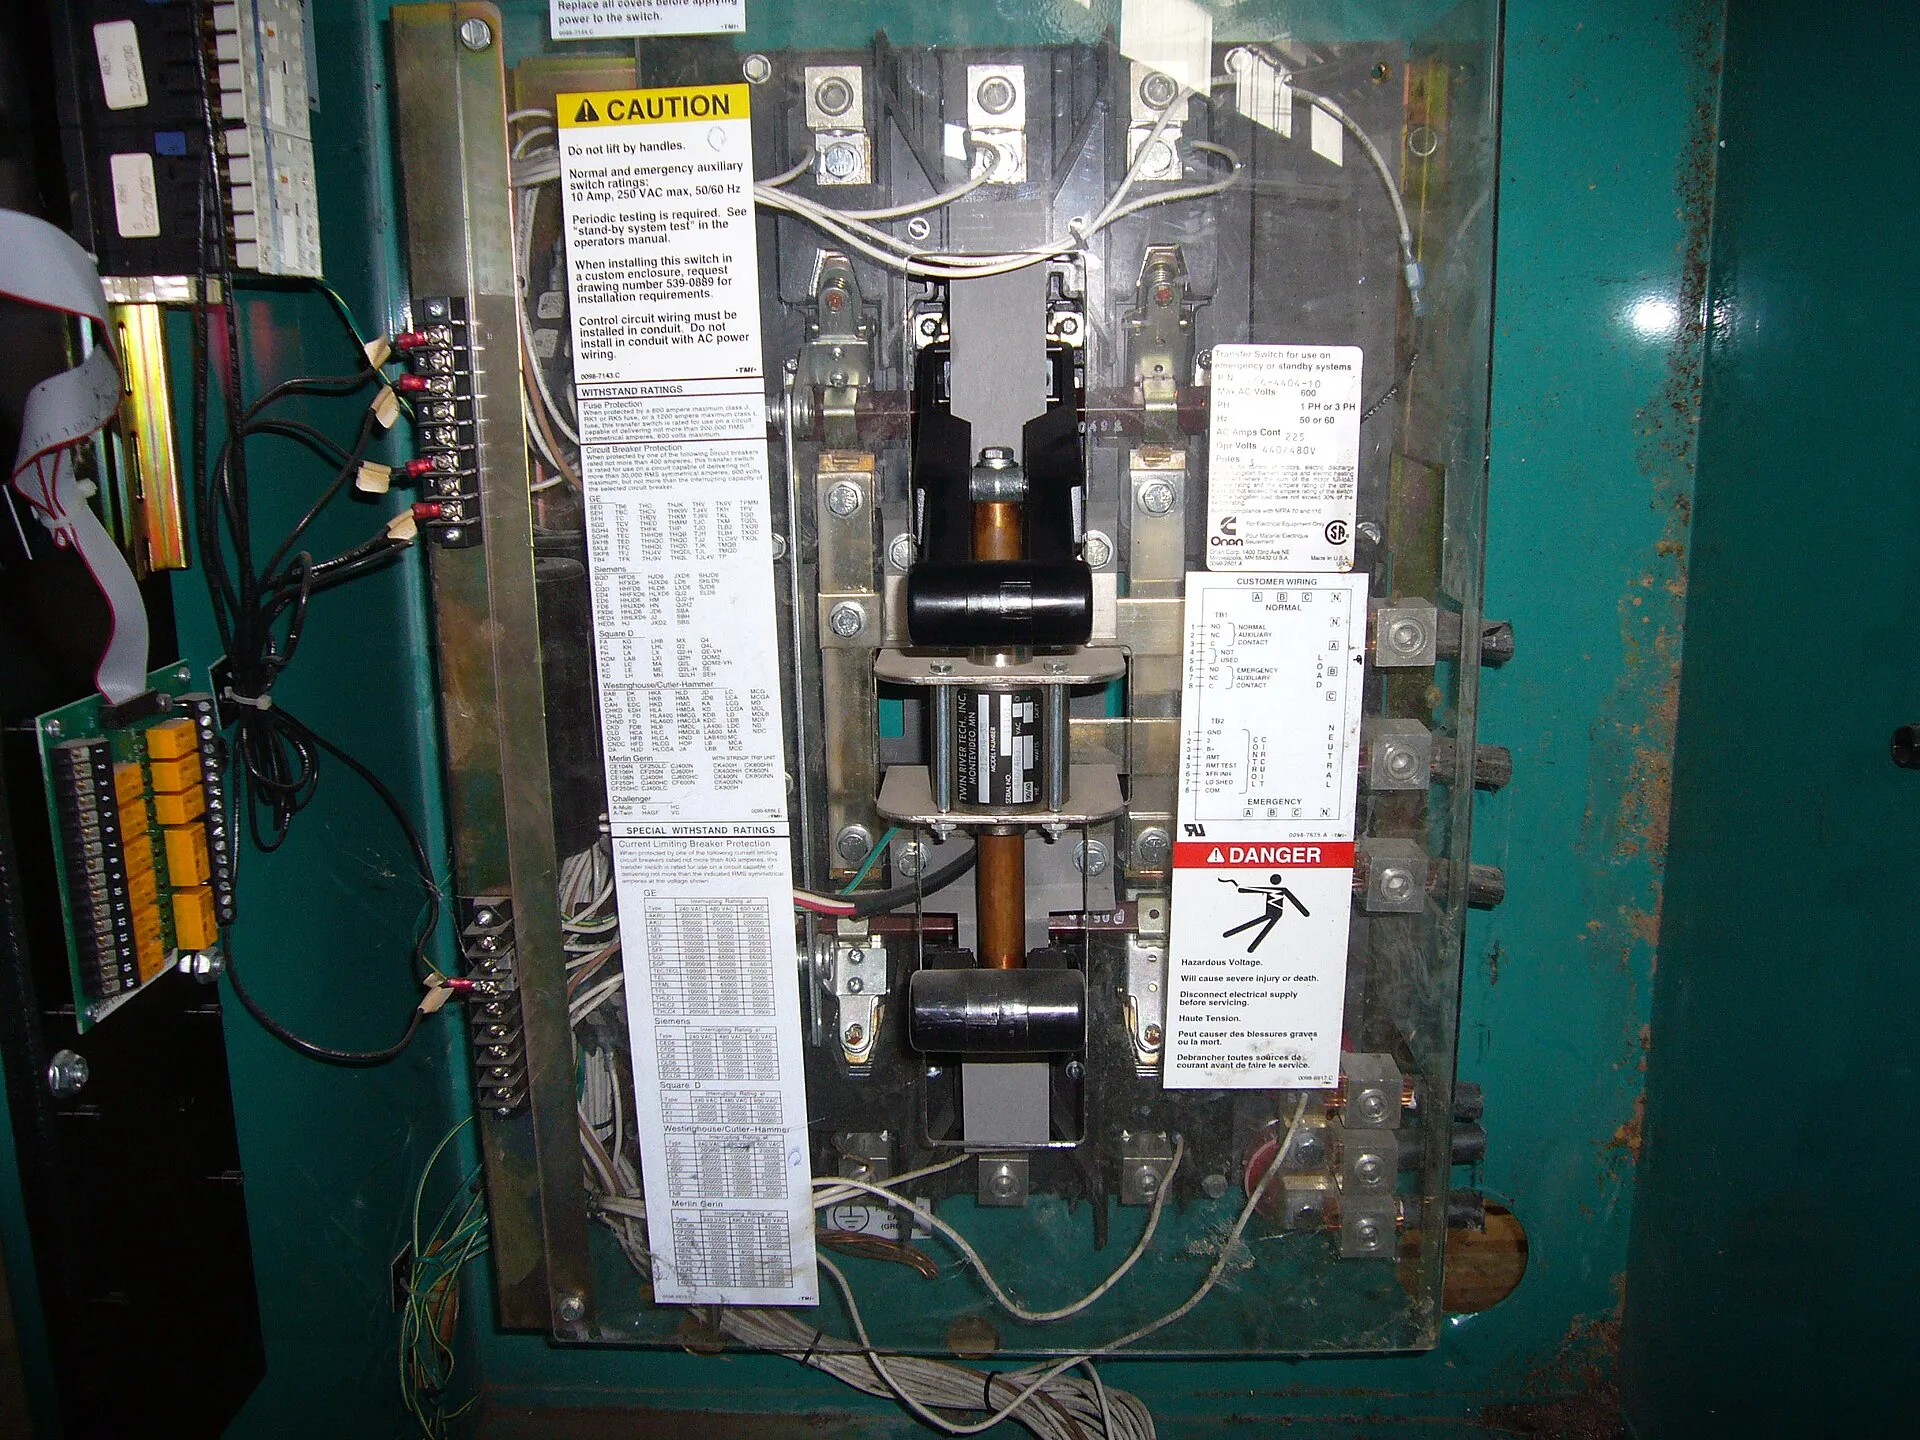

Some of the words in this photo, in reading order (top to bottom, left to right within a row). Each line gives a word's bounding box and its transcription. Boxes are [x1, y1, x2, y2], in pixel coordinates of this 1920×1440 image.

[558, 1, 598, 12] Replace
[602, 0, 614, 9] all
[618, 0, 654, 8] covers
[558, 16, 589, 27] power
[593, 13, 603, 24] to
[606, 12, 623, 23] the
[626, 11, 662, 22] switch.
[607, 94, 730, 121] CAUTION
[568, 146, 583, 156] Do
[586, 145, 603, 155] not
[606, 144, 620, 154] lift
[623, 143, 636, 155] by
[640, 141, 685, 152] handles.
[569, 167, 608, 181] Normal
[611, 166, 631, 179] and
[634, 165, 694, 176] emergency
[697, 162, 743, 172] auxiliary
[570, 179, 605, 190] switch
[608, 178, 649, 190] ratings:
[571, 192, 583, 202] 10
[586, 191, 614, 203] Amp,
[617, 188, 637, 199] 250
[639, 187, 663, 198] VAC
[666, 188, 692, 197] max,
[696, 184, 724, 195] 50/60
[727, 184, 740, 194] Hz
[572, 213, 616, 225] Periodic
[619, 211, 656, 223] testing
[659, 210, 669, 220] is
[672, 208, 720, 221] required.
[727, 207, 747, 217] See
[575, 260, 605, 270] When
[608, 257, 658, 269] installing
[661, 256, 681, 266] this
[684, 254, 719, 265] switch
[722, 253, 732, 264] in
[576, 274, 582, 283] a
[585, 271, 625, 282] custom
[628, 268, 684, 281] enclosure,
[687, 265, 728, 279] request
[577, 282, 621, 295] drawing
[622, 280, 665, 291] number
[666, 277, 714, 288] 539-0889
[717, 276, 732, 286] for
[578, 292, 636, 304] installation
[639, 289, 713, 303] requirements.
[580, 338, 612, 350] install
[615, 338, 625, 347] in
[628, 336, 668, 347] conduit
[671, 334, 694, 344] with
[697, 333, 713, 343] AC
[716, 334, 749, 345] power
[581, 349, 616, 361] wiring.
[1279, 362, 1313, 372] standby
[1316, 363, 1352, 372] systems
[581, 387, 638, 397] WITHSTAND
[640, 385, 683, 394] RATINGS
[603, 399, 642, 408] Protection
[1335, 403, 1340, 411] 3
[1343, 403, 1356, 411] PH
[1300, 416, 1310, 424] 50
[1324, 416, 1335, 424] 60
[1260, 428, 1281, 436] Cont
[585, 443, 609, 453] Circuit
[610, 443, 642, 452] Breaker
[643, 443, 682, 452] Protection
[589, 495, 601, 503] GE
[1210, 536, 1244, 546] Onan
[1286, 578, 1317, 586] WIRING
[599, 630, 626, 638] Square
[958, 693, 967, 713] INC.
[968, 712, 976, 725] MN
[633, 754, 654, 762] Gerin
[958, 746, 967, 772] RIVER
[958, 775, 967, 800] TWIN
[626, 827, 667, 835] SPECIAL
[672, 826, 728, 834] WITHSTAND
[733, 826, 776, 834] RATINGS
[618, 840, 651, 848] Current
[653, 840, 687, 849] Limiting
[689, 840, 723, 848] Breaker
[726, 838, 771, 848] Protection
[1230, 847, 1321, 864] DANGER
[643, 889, 657, 897] GE
[1229, 959, 1263, 967] Voltage.
[1256, 974, 1280, 984] injury
[1270, 991, 1298, 1000] supply
[1209, 999, 1249, 1008] servicing.
[654, 1017, 691, 1025] Siemens
[1178, 1030, 1197, 1040] Peut
[1199, 1032, 1228, 1040] causer
[1290, 1032, 1318, 1040] graves
[659, 1081, 690, 1090] Square
[694, 1081, 701, 1089] D
